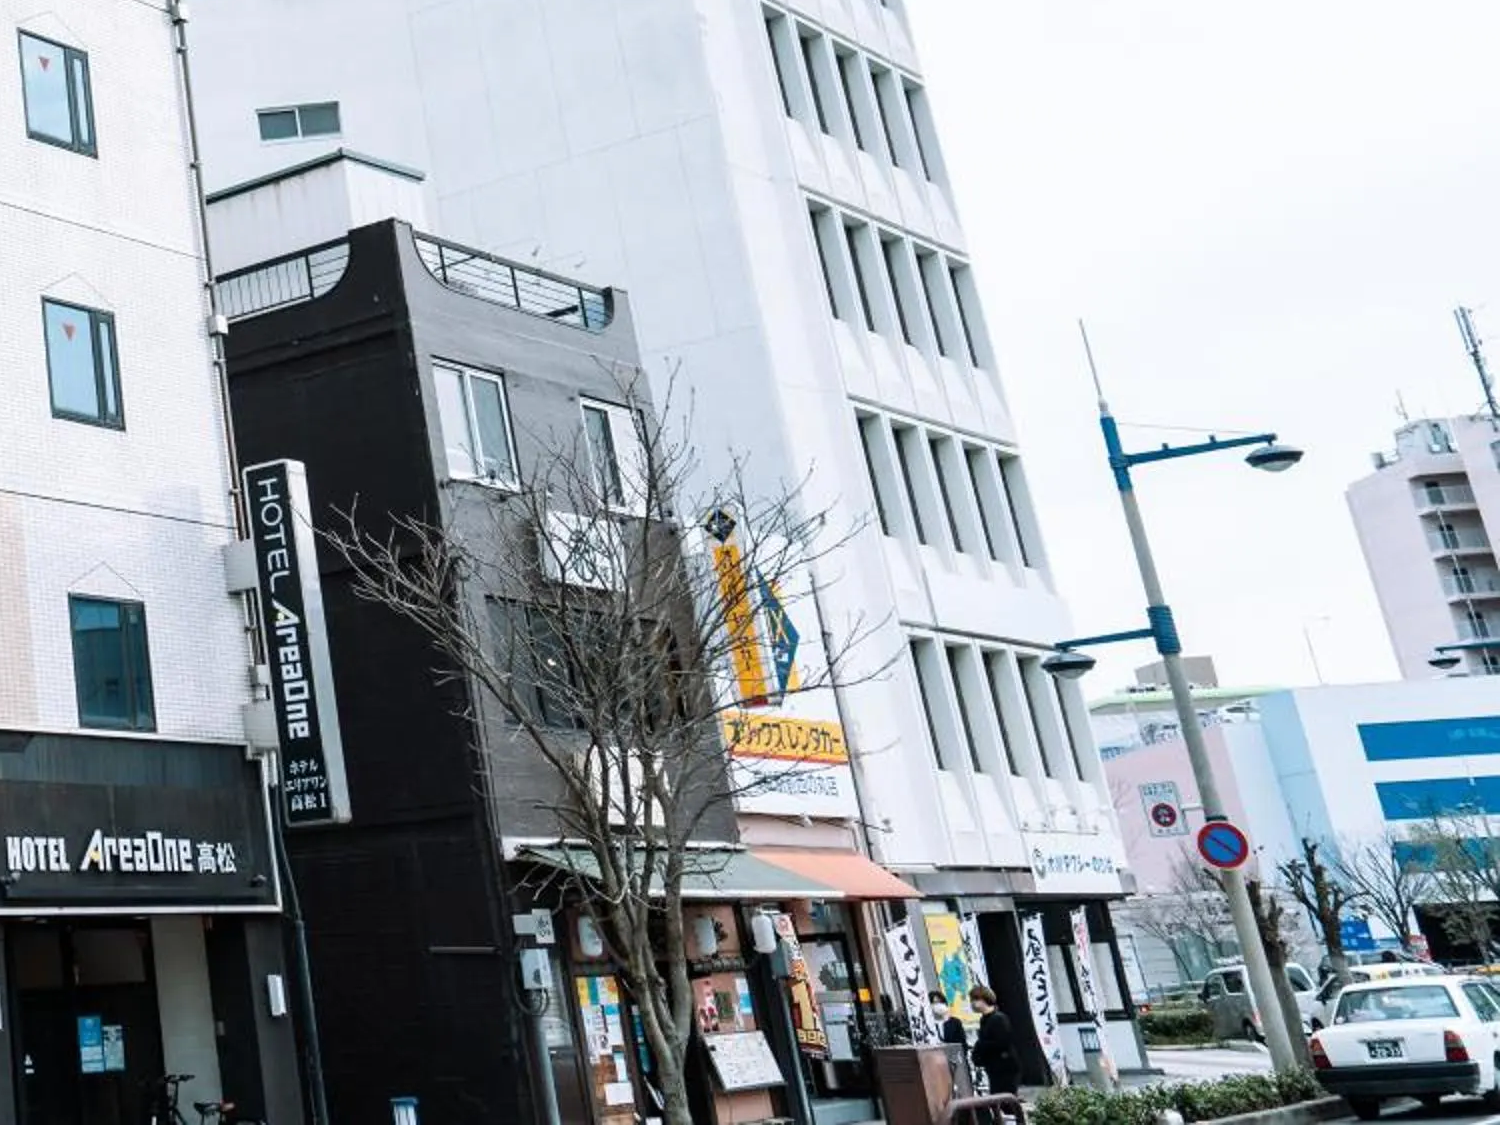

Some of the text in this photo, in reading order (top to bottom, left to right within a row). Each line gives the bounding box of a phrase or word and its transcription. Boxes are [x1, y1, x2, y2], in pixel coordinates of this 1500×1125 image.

[257, 478, 291, 592] HOTEL
[6, 836, 71, 871] HOTEL
[197, 842, 238, 874] 高松
